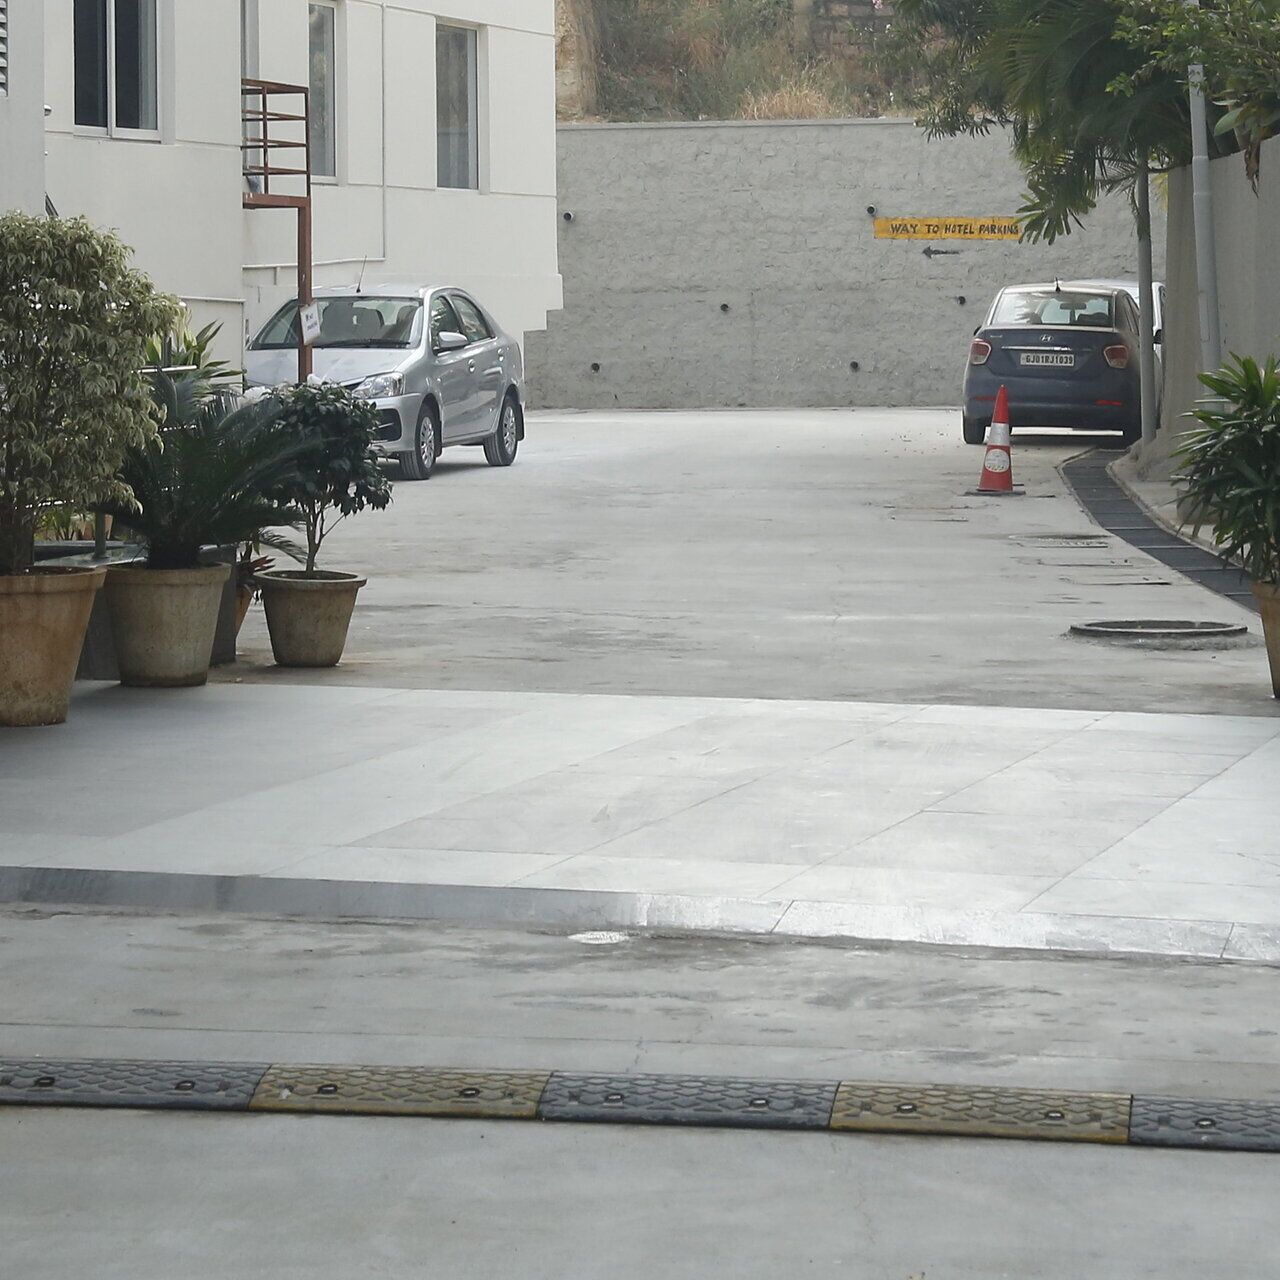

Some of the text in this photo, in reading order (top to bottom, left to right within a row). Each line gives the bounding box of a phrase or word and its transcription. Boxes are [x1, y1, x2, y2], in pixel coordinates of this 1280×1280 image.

[890, 223, 1019, 235] WAY TO HOTEL PARKING
